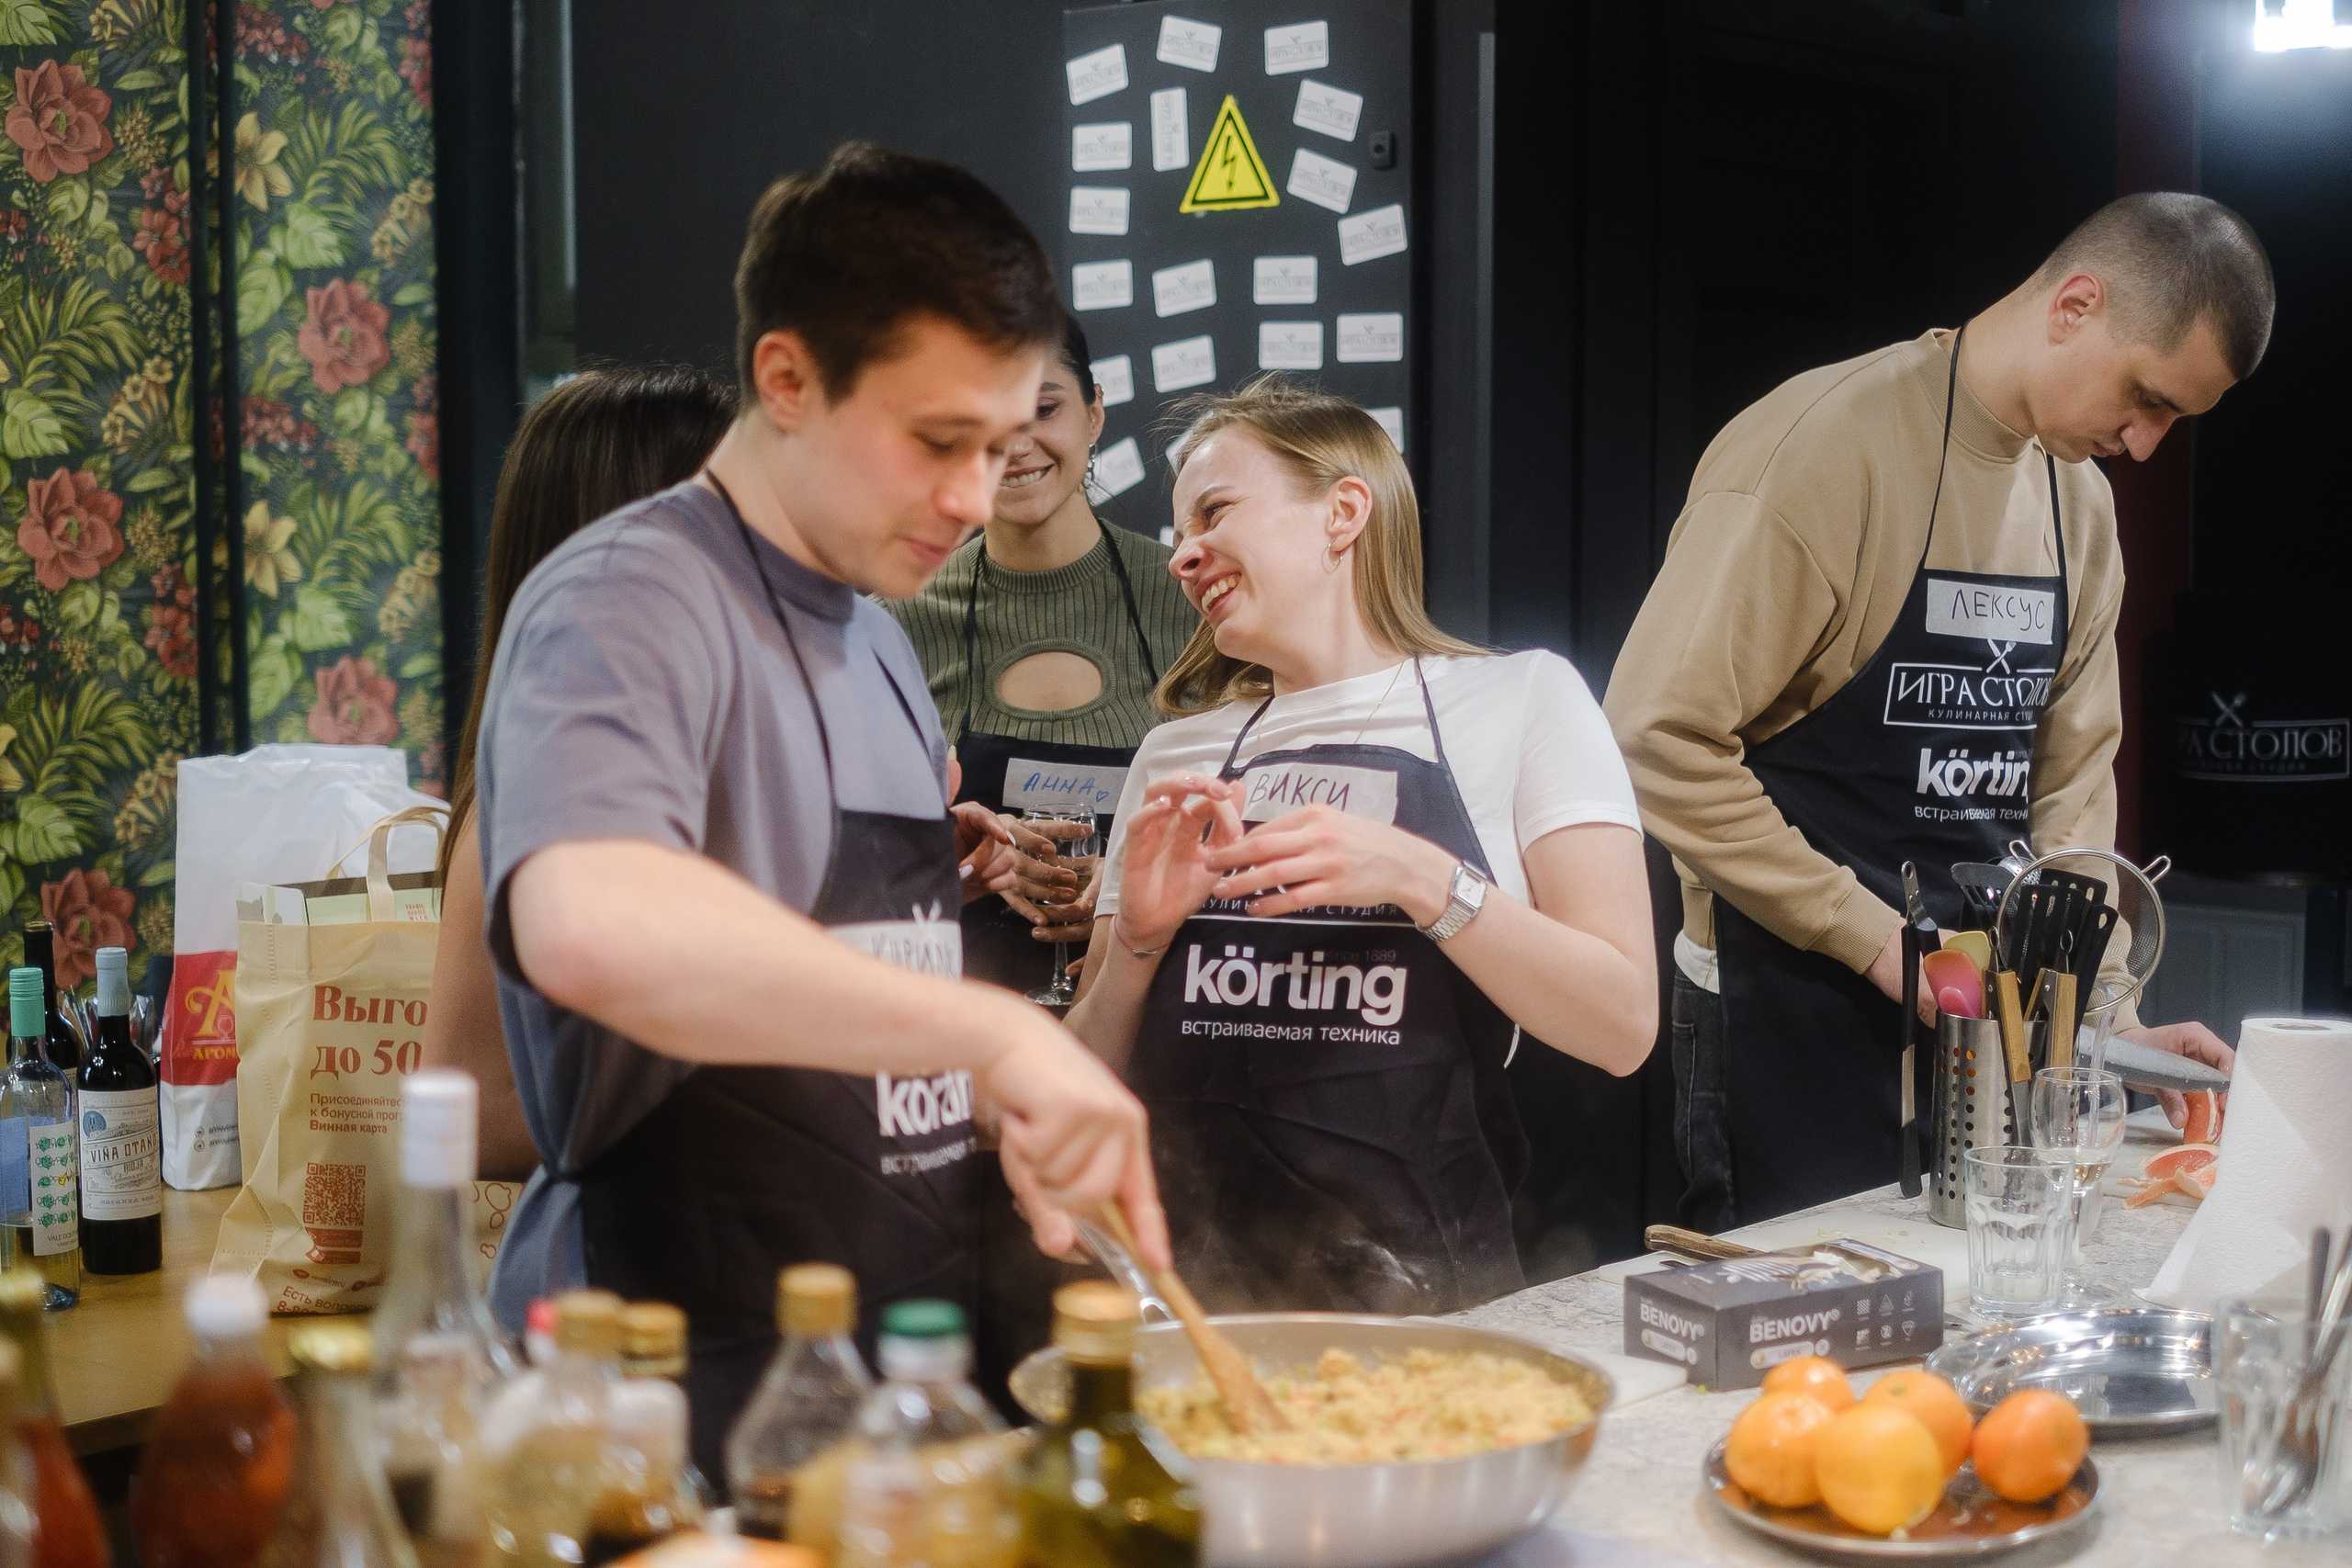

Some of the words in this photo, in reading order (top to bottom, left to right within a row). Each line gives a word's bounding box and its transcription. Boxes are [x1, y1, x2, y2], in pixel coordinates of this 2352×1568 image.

[1951, 589, 2045, 631] ЛЕКСУС
[1897, 671, 1977, 706] ИГРА
[1928, 708, 2009, 721] КУЛИНАРНАЯ
[1023, 772, 1096, 795] АННА
[1917, 748, 2030, 802] körtin
[1249, 773, 1351, 811] ВИКСИ
[1326, 952, 1360, 962] since
[1365, 950, 1396, 963] 1889
[1184, 944, 1408, 1026] körting
[312, 985, 428, 1027] Выго
[1182, 1020, 1313, 1042] встраиваемая
[1319, 1023, 1401, 1045] техника
[310, 1045, 362, 1081] до
[370, 1039, 423, 1077] 50
[310, 1108, 318, 1117] к
[321, 1106, 374, 1121] бонусной
[310, 1119, 357, 1133] Винная
[359, 1124, 388, 1135] карта
[90, 1145, 119, 1163] VIÑA
[124, 1159, 144, 1174] RIOJA
[282, 1285, 312, 1305] Есть
